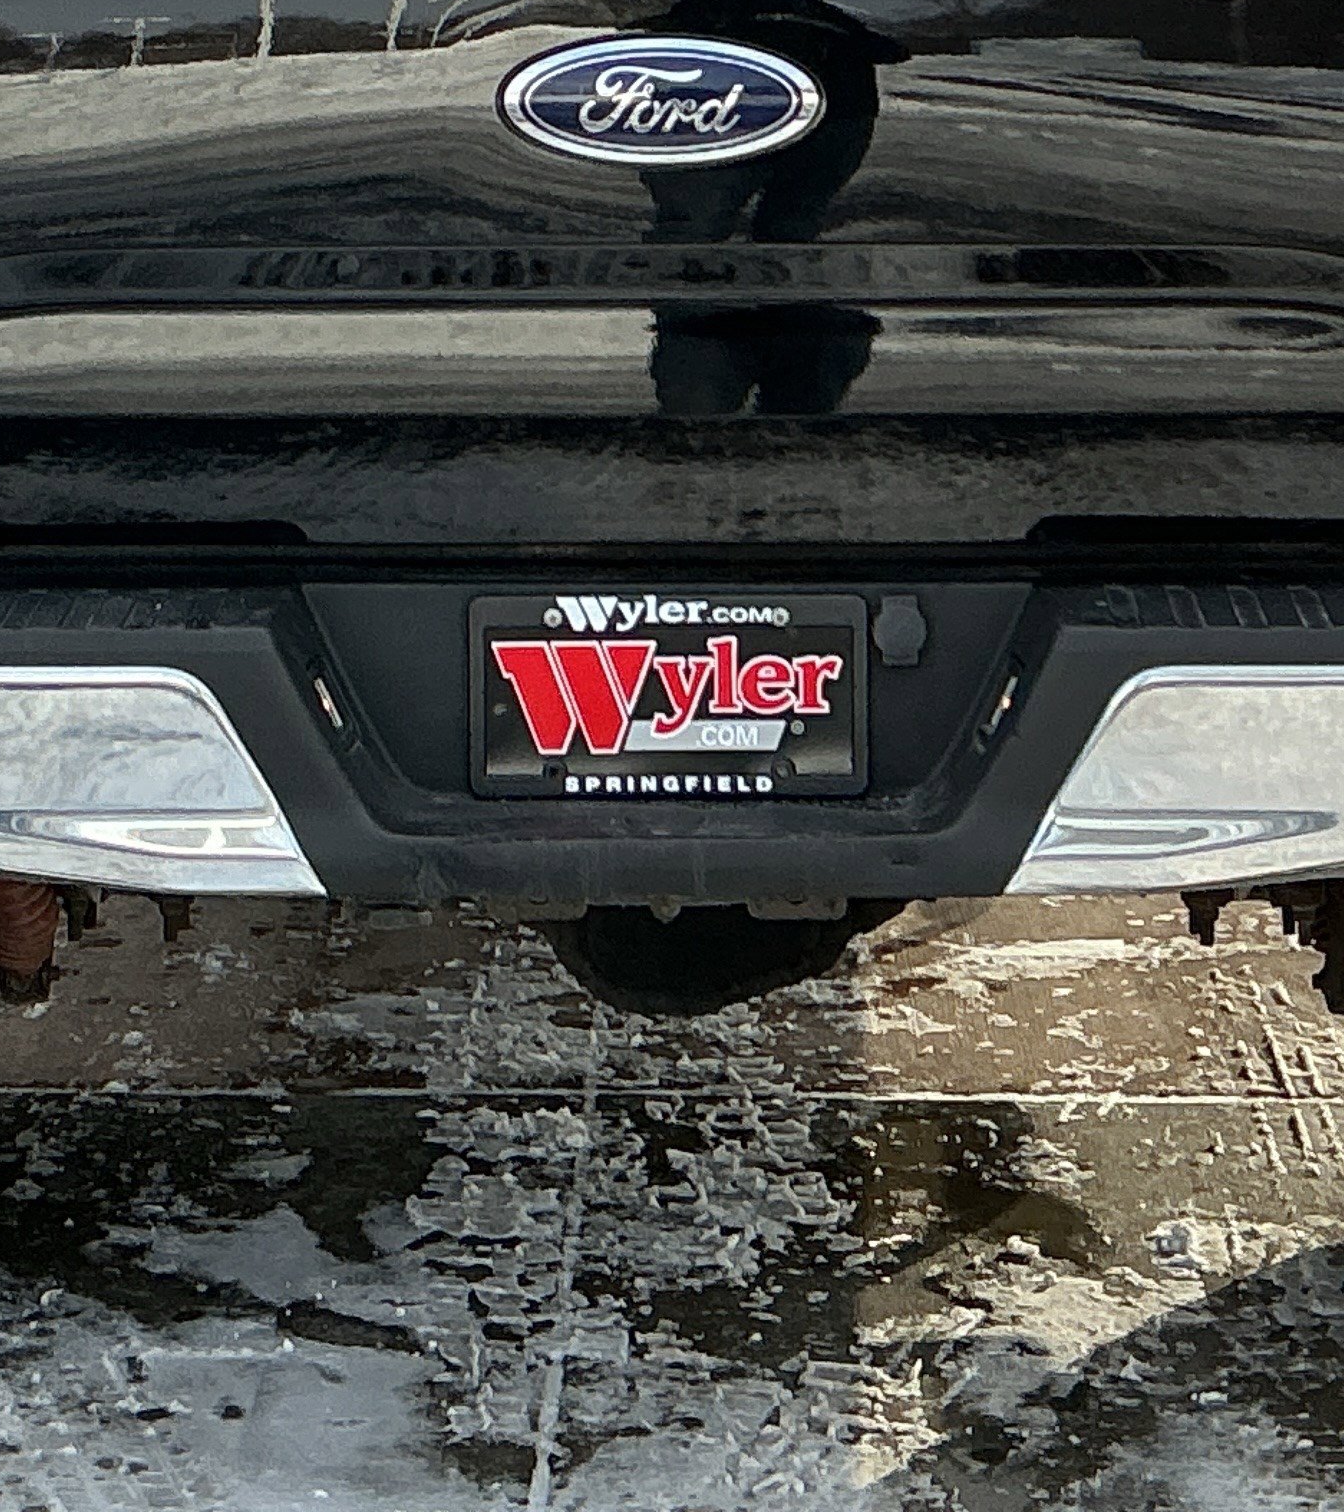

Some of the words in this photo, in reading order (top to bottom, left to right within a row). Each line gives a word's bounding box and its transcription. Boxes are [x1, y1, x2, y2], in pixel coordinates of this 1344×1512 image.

[578, 65, 745, 133] Ford
[490, 635, 844, 756] Wyler
[695, 723, 760, 748] .COM
[564, 774, 774, 794] SPRINGFIELD
